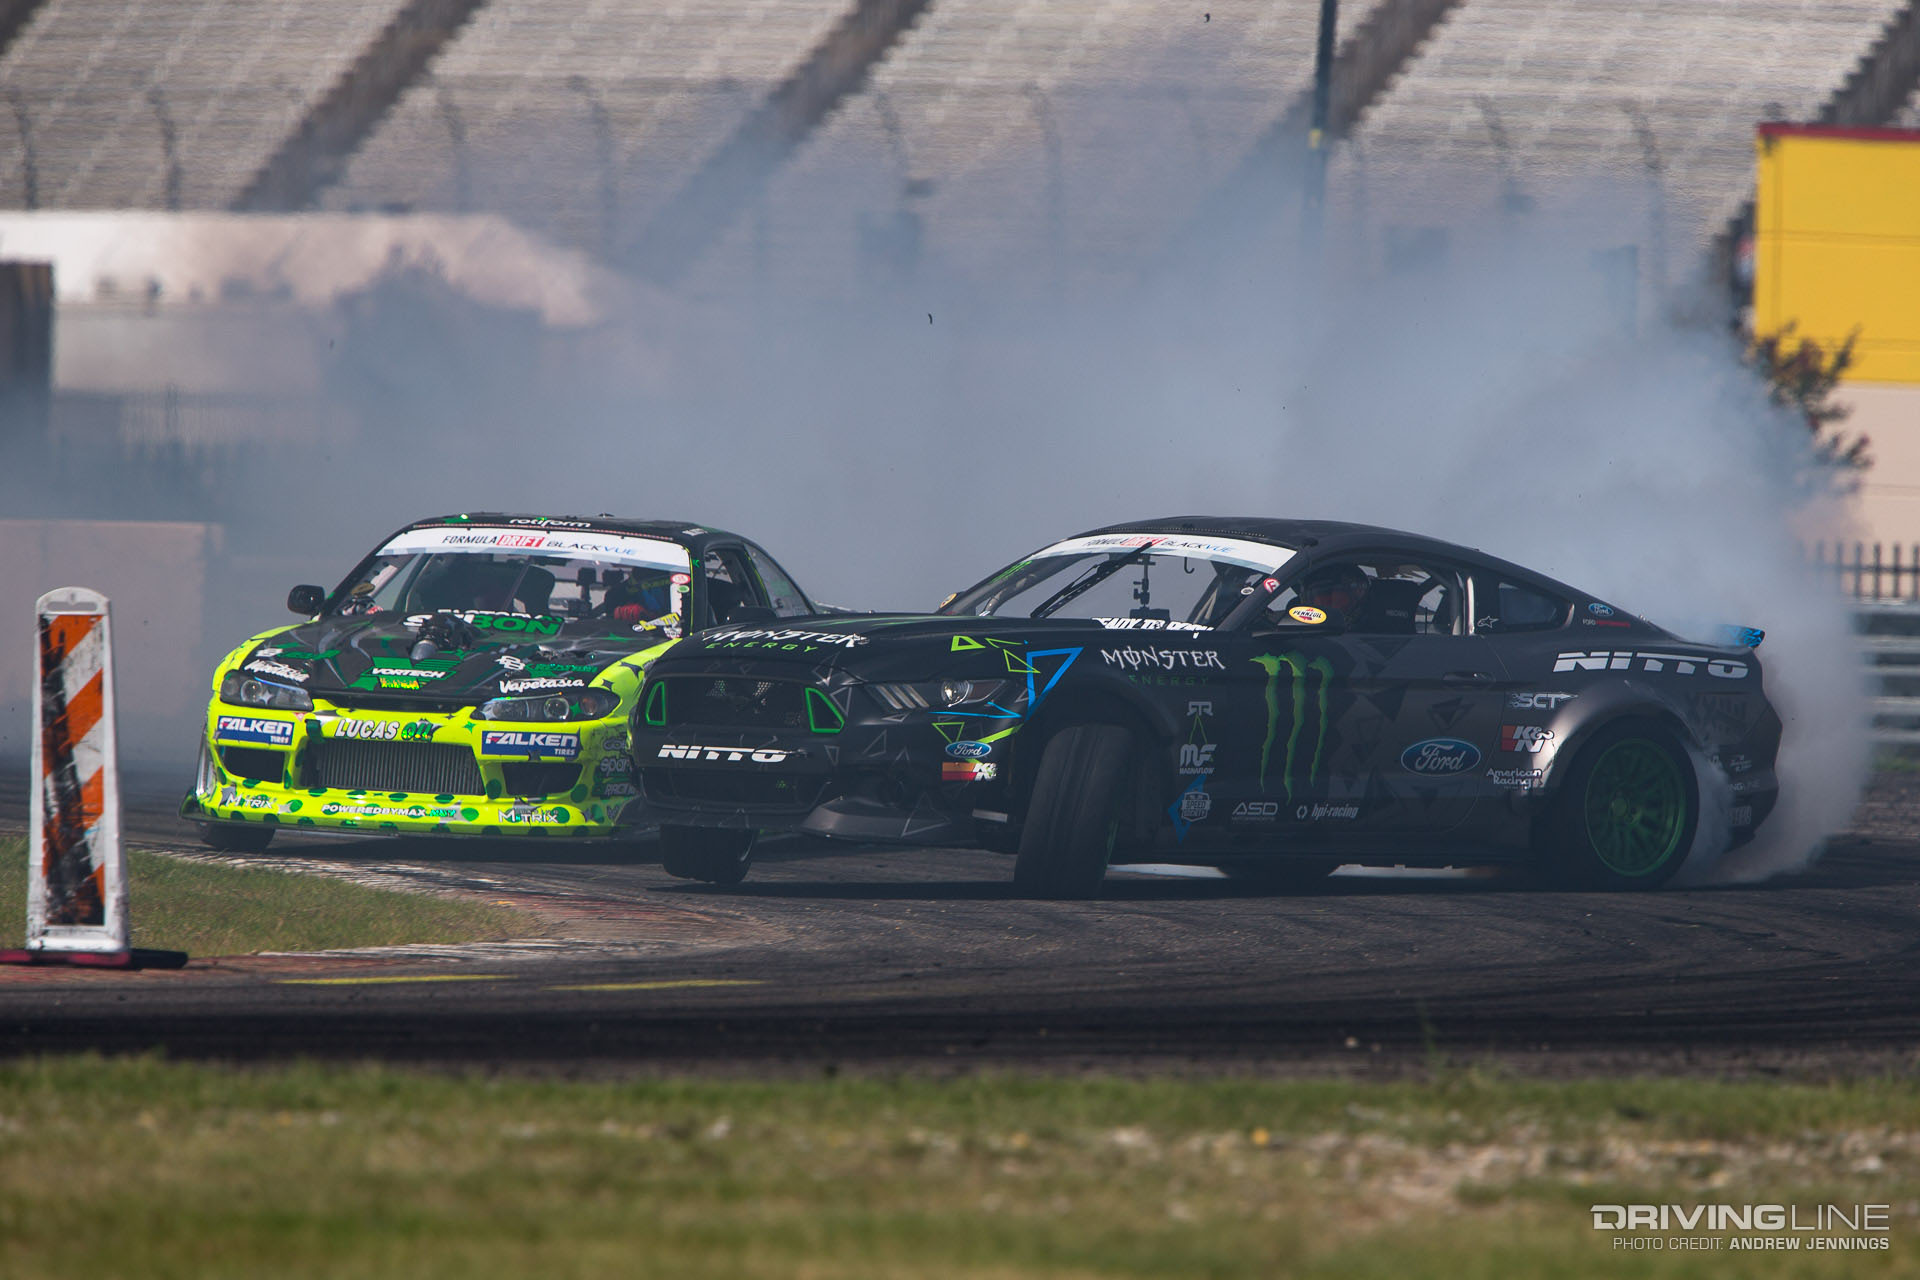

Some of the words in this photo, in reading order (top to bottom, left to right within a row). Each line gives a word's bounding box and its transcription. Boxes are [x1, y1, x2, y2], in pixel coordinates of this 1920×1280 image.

[508, 517, 591, 528] rotiform
[441, 535, 498, 545] FORMULA
[498, 534, 544, 547] DRIFT
[546, 540, 637, 555] BLACKVUE
[704, 642, 818, 652] ENERGY
[1100, 645, 1226, 671] MONSTER
[1552, 651, 1749, 679] NITTO
[371, 667, 446, 679] VORTECH
[499, 677, 585, 693] Vapetasia
[1515, 692, 1565, 709] SCT
[219, 716, 294, 736] FALKEN
[334, 719, 400, 741] LUCAS
[485, 732, 578, 747] FALKEN
[1512, 725, 1555, 753] K&N
[554, 748, 576, 756] TIRES
[657, 744, 787, 763] NITTO
[953, 743, 983, 756] Ford
[1415, 743, 1467, 770] Ford
[1486, 768, 1542, 777] American
[1492, 776, 1532, 789] Racing
[1231, 802, 1278, 815] ASD
